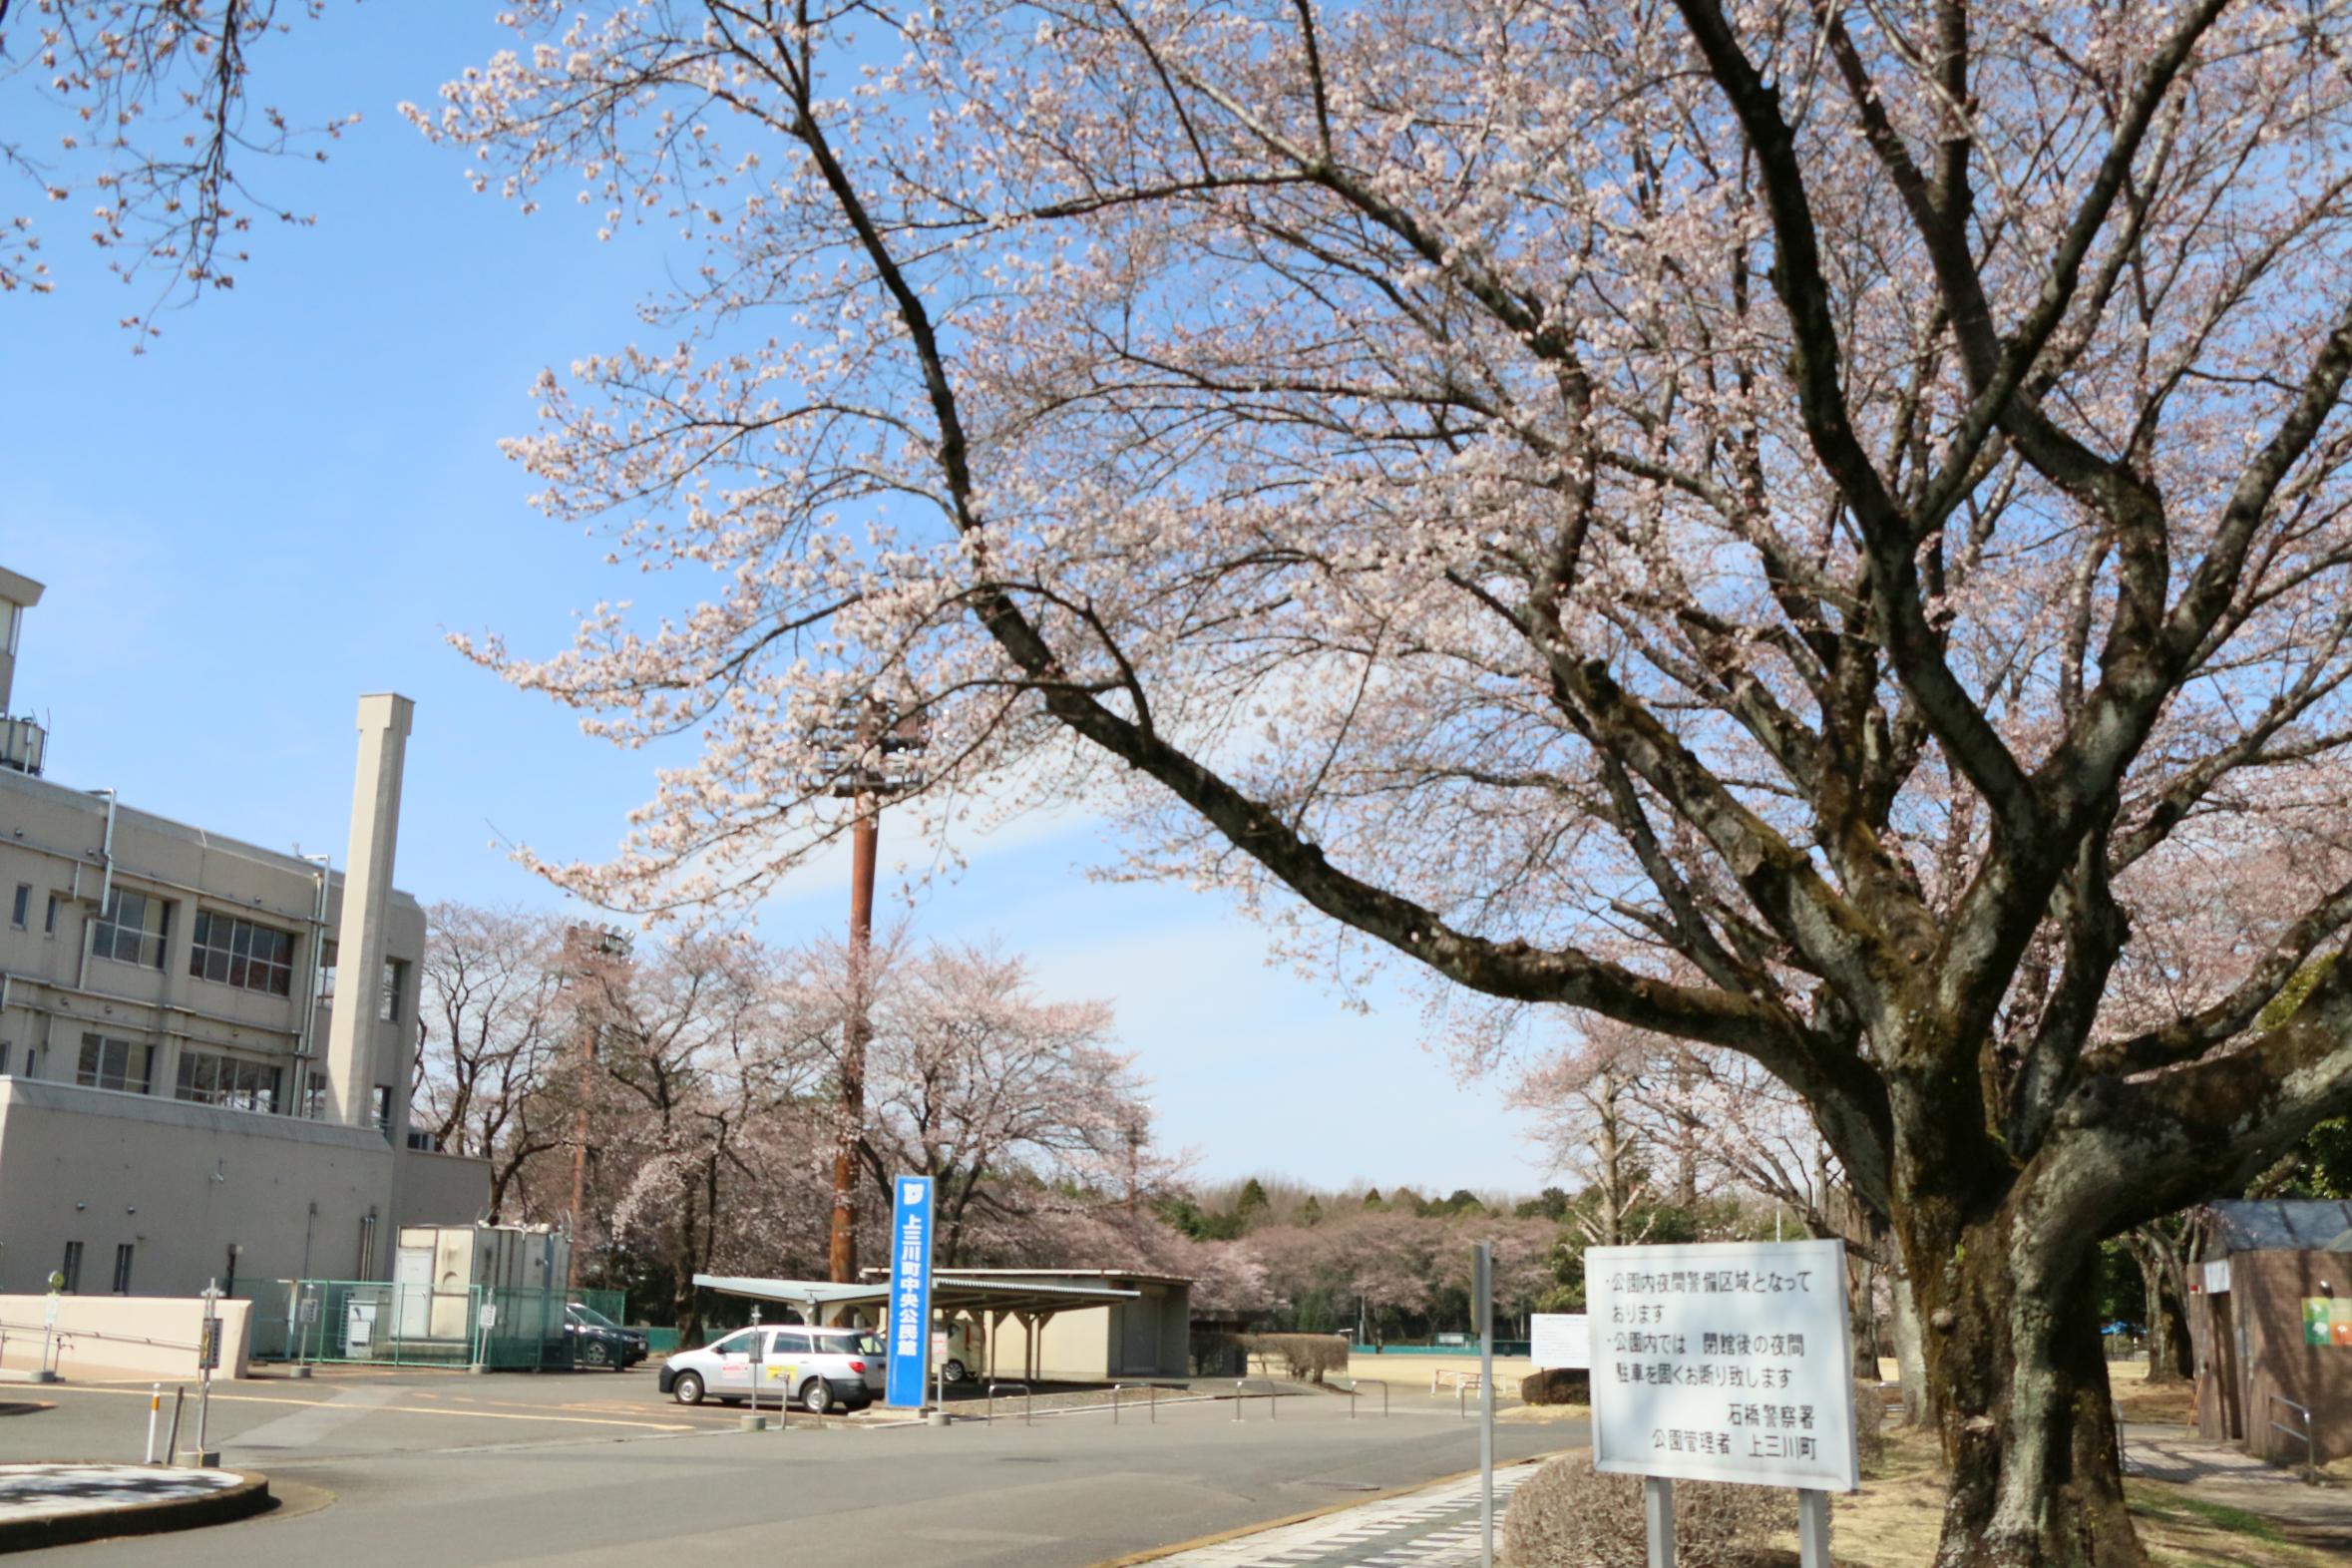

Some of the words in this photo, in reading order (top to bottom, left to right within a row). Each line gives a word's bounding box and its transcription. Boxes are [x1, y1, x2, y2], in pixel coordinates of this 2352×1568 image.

[1728, 1403, 1815, 1429] 石橋警察署
[1652, 1428, 1732, 1455] 公園管理者
[1749, 1433, 1816, 1460] 上三川町
